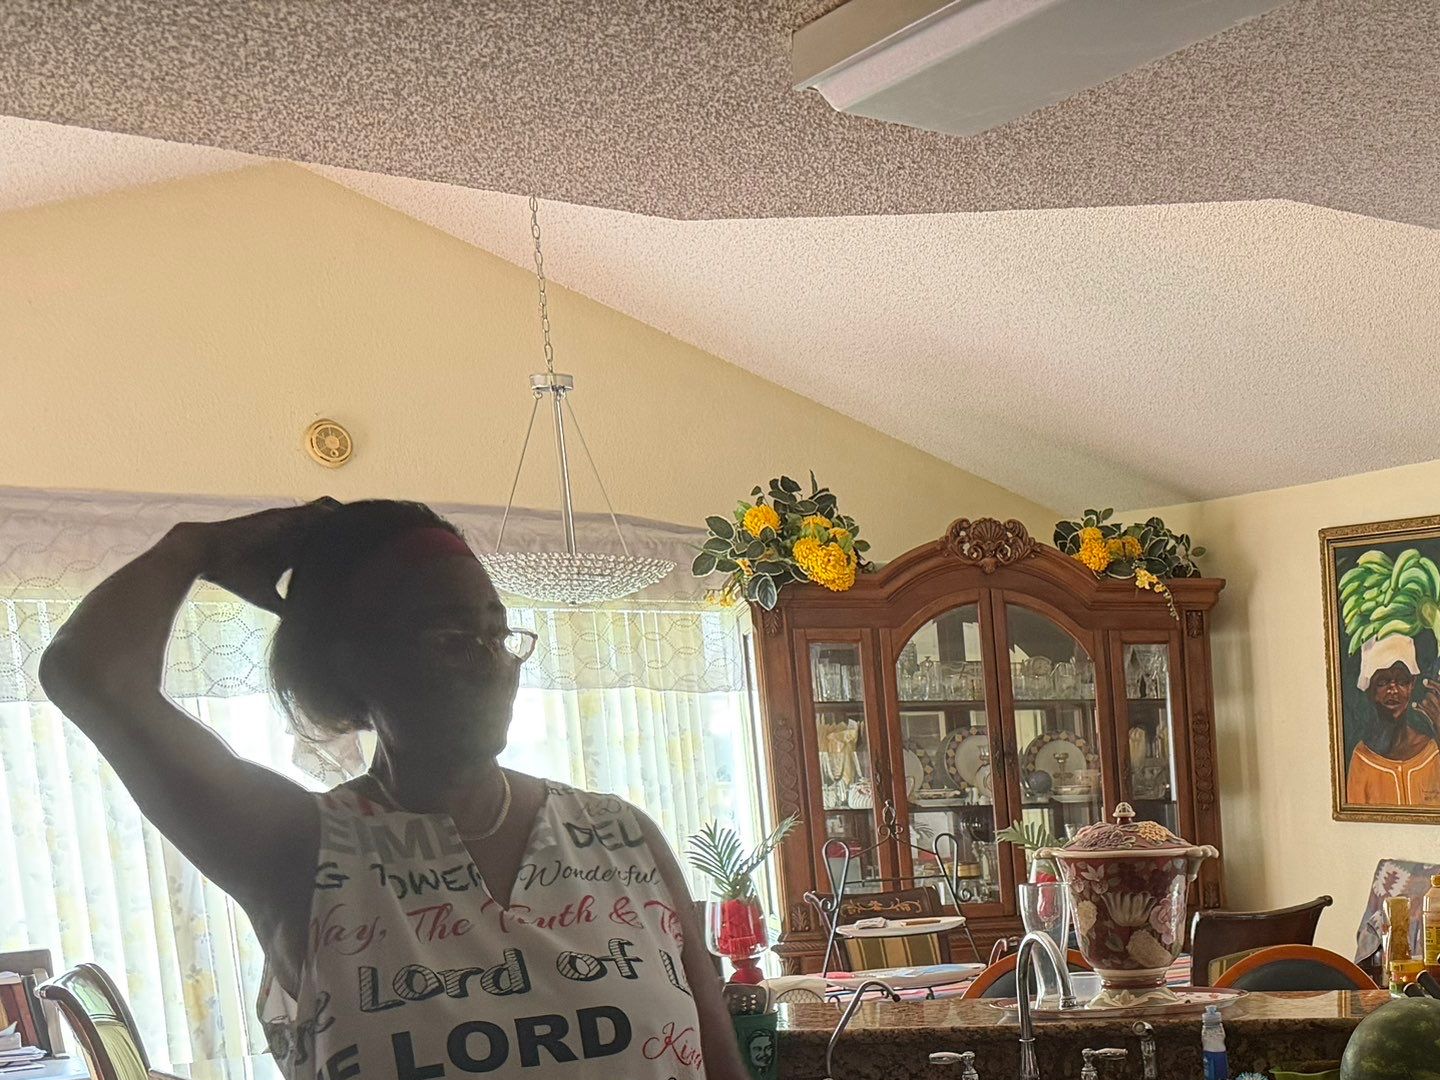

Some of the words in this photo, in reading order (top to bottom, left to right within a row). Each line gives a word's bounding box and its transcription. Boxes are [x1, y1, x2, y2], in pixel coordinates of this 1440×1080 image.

[406, 902, 475, 942] The
[609, 896, 645, 930] &
[358, 947, 531, 1012] Lord
[556, 938, 644, 982] of
